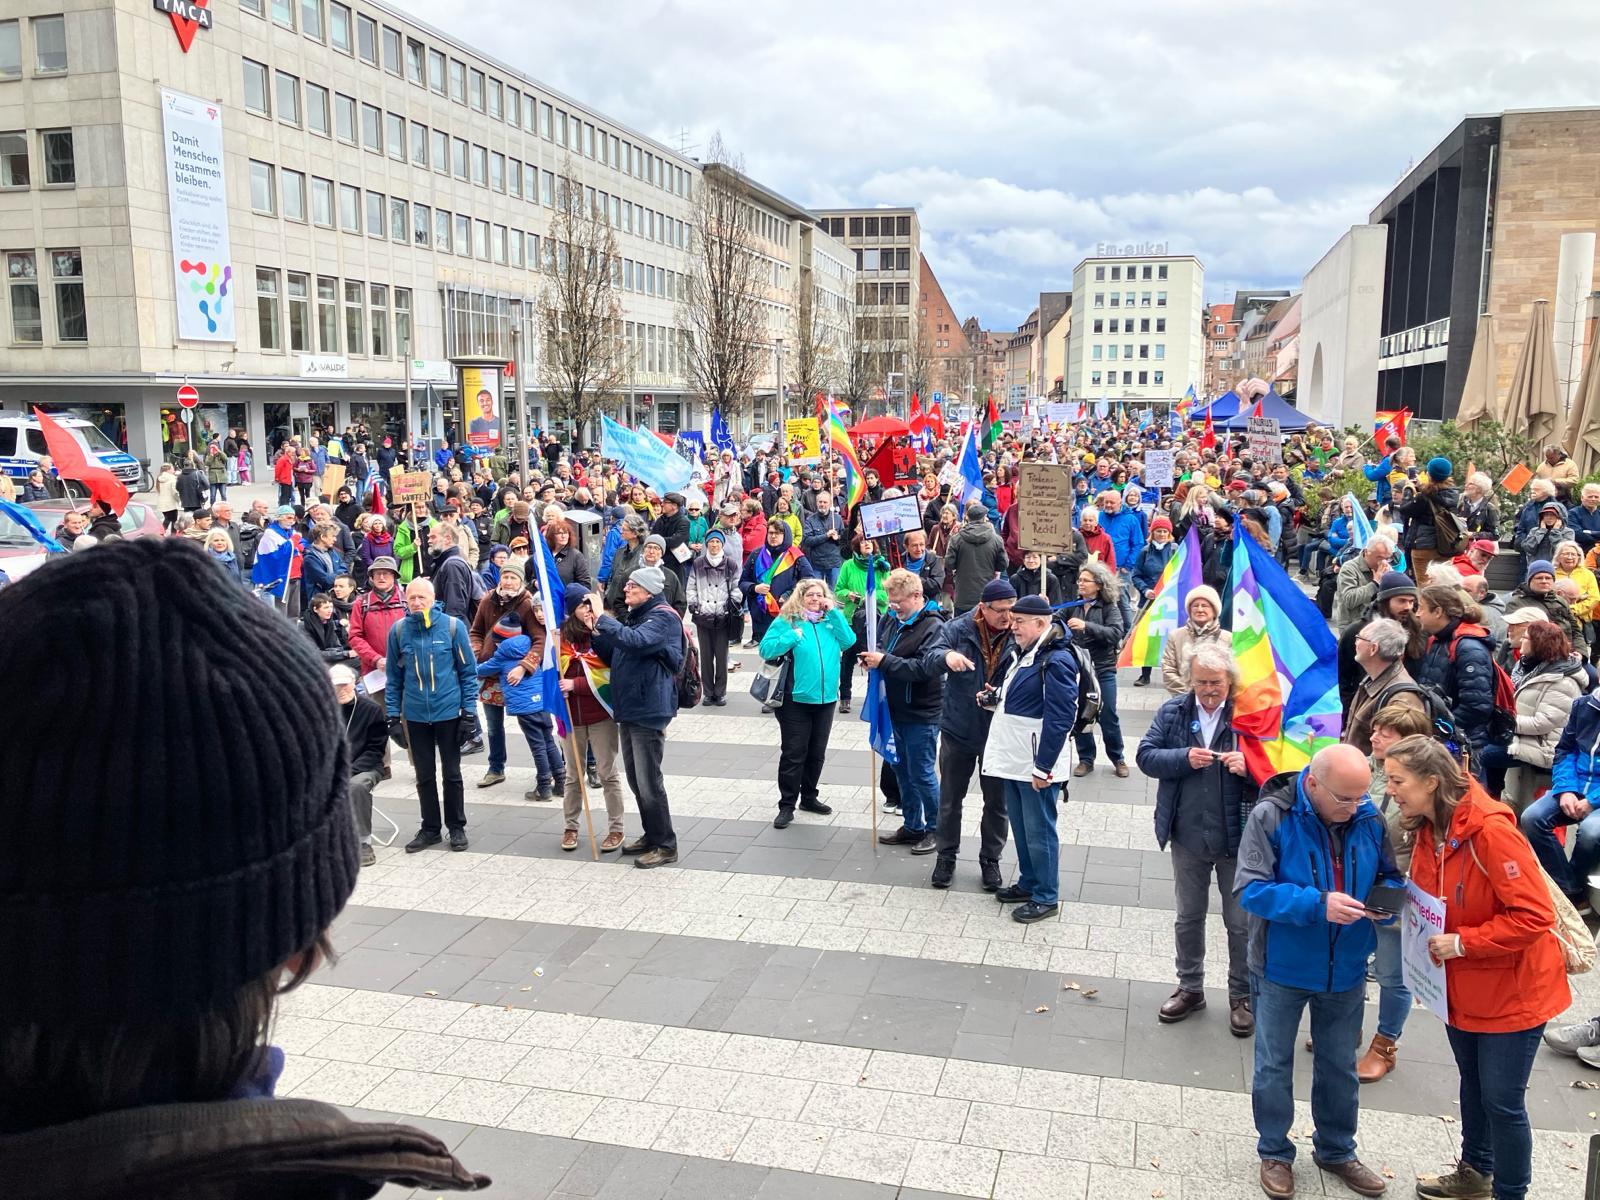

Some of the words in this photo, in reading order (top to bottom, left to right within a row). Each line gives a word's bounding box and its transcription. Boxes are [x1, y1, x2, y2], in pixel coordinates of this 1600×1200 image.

[162, 0, 208, 25] YMCA
[172, 130, 199, 148] Damit
[173, 144, 219, 165] Menschen
[174, 160, 221, 179] zusammen
[175, 170, 212, 190] bleiben.
[320, 363, 346, 371] VAUDE
